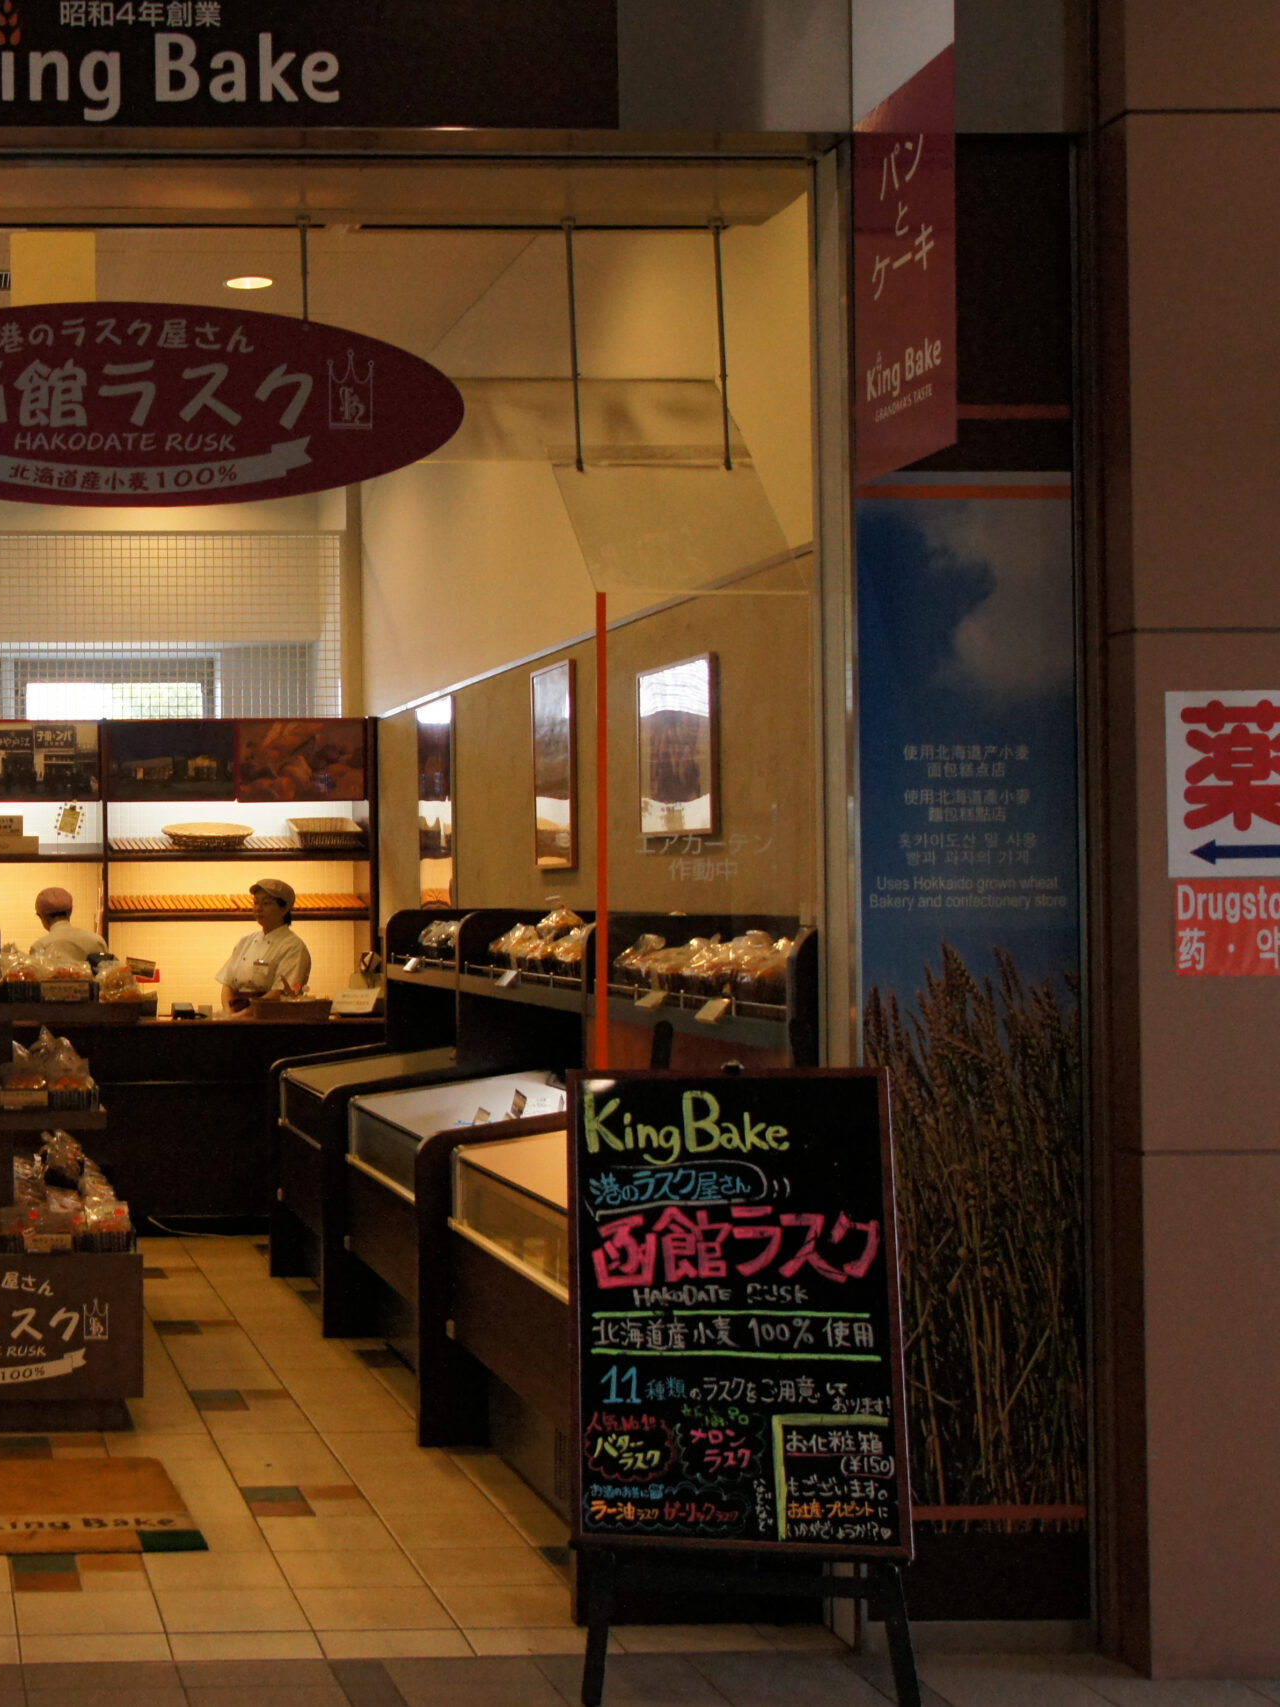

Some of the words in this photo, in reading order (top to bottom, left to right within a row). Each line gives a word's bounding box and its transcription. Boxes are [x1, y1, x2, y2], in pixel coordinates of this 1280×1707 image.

[59, 0, 222, 28] 昭和4年創業
[154, 32, 341, 103] Bake
[880, 133, 923, 201] パン
[895, 202, 909, 238] と
[872, 223, 934, 301] ケーキ
[866, 356, 901, 403] King
[904, 336, 942, 383] Bake
[874, 392, 912, 423] GRANDMA'S
[911, 382, 934, 408] TASTE
[14, 431, 160, 453] HAKODATE
[164, 431, 238, 453] RUSK
[7, 464, 239, 493] 北海道産小麦100%
[635, 833, 773, 855] エアカーテン
[669, 858, 738, 881] 作動中
[876, 876, 911, 891] Uses
[914, 876, 975, 891] Hokkaido
[976, 879, 1016, 894] grown
[1019, 876, 1059, 891] wheat
[869, 893, 914, 911] Bakery
[916, 894, 947, 908] and
[947, 894, 1033, 911] confectionery
[1034, 894, 1067, 908] store
[1177, 884, 1280, 924] Drugsto
[1177, 927, 1206, 971] 药
[584, 1091, 681, 1165] King
[681, 1089, 791, 1154] Bake
[589, 1167, 753, 1206] 港のラスク屋さん
[590, 1205, 883, 1289] 函館ラスク
[632, 1284, 733, 1308] HAKODATE
[745, 1282, 811, 1305] RUSK
[592, 1317, 739, 1351] 北海道産小麦
[748, 1317, 815, 1351] 100%
[822, 1319, 875, 1350] 使用
[6, 1345, 48, 1358] RUSK
[832, 1395, 893, 1416] おります!
[593, 1433, 646, 1460] バター
[689, 1428, 748, 1449] メロン
[785, 1430, 885, 1454] お化粧箱
[618, 1450, 662, 1472] ラスク
[703, 1449, 752, 1474] ラスク
[839, 1455, 896, 1479] (¥150)
[786, 1475, 891, 1502] もございます。
[82, 1515, 177, 1530] Bake
[589, 1500, 661, 1523] ラー油ラスク
[663, 1500, 741, 1525] ガーリックラスク
